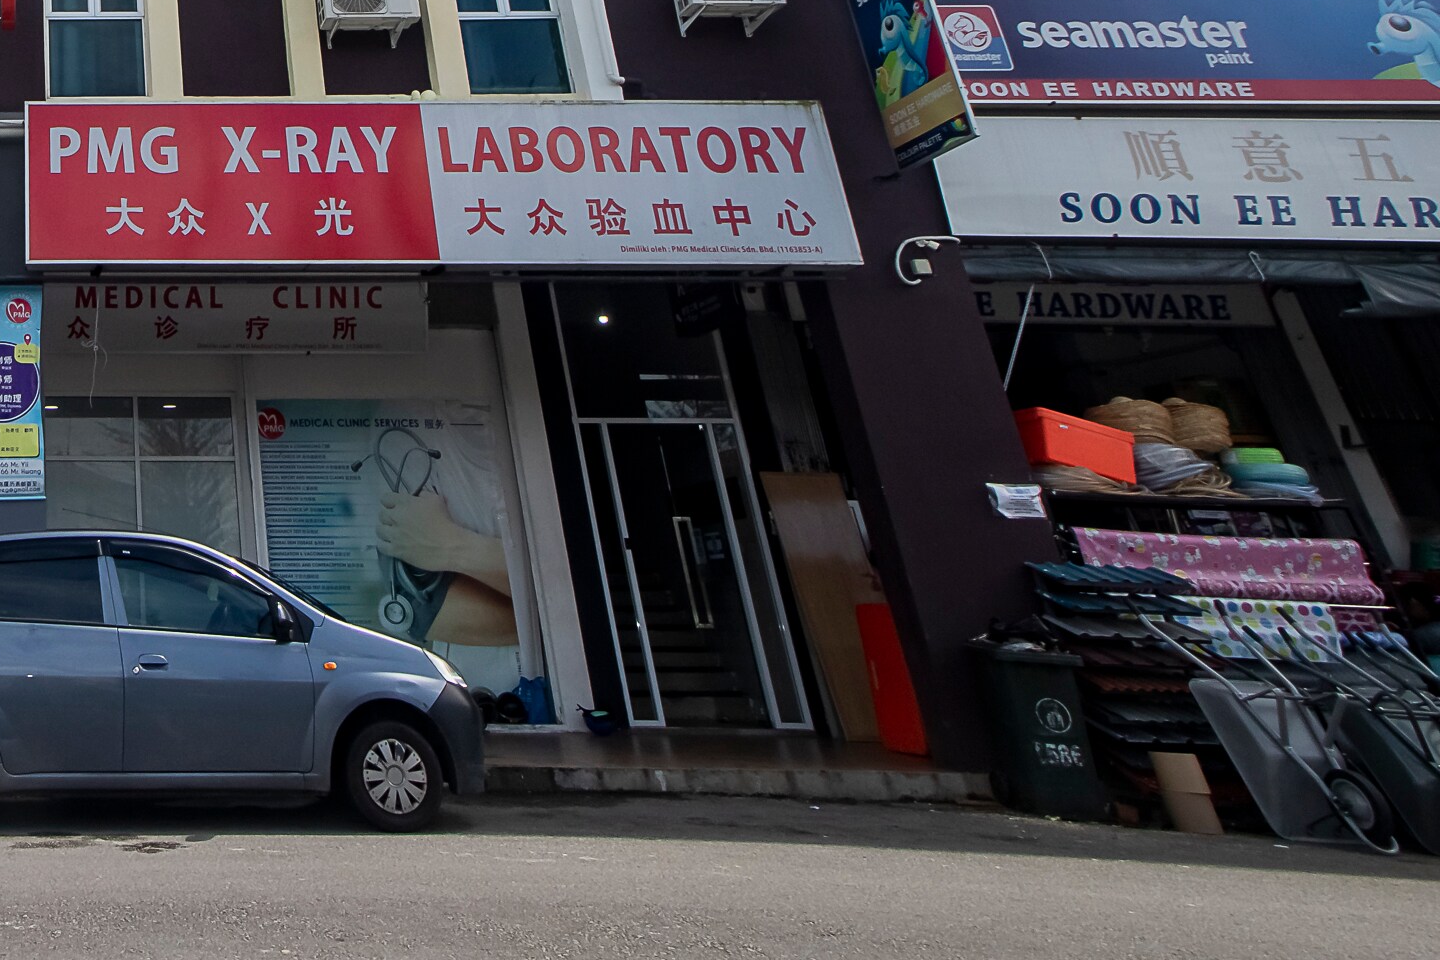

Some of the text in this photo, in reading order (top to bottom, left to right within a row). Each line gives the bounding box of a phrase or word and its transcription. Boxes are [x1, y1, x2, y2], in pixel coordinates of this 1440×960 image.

[1016, 15, 1247, 49] seamaster
[1205, 49, 1253, 68] paint
[1041, 82, 1080, 97] EE
[1092, 81, 1255, 97] HARDWARE
[48, 125, 398, 174] PMG X-RAY
[436, 125, 807, 174] LABORATORY
[463, 197, 817, 237] 大众验血中心
[1059, 191, 1440, 228] SOON EE HAR
[620, 245, 650, 254] Dimiliki
[650, 245, 667, 254] oleh
[672, 245, 689, 254] PMG
[690, 245, 719, 254] Medical
[720, 245, 741, 254] Clinic
[741, 245, 759, 254] Sdn.
[759, 245, 777, 254] Bhd.
[74, 285, 384, 310] MEDICAL CLINIC
[1017, 291, 1231, 321] HARDWARE
[289, 418, 334, 428] MEDICAL
[336, 418, 371, 428] CLINIC
[374, 418, 420, 429] SERVICES
